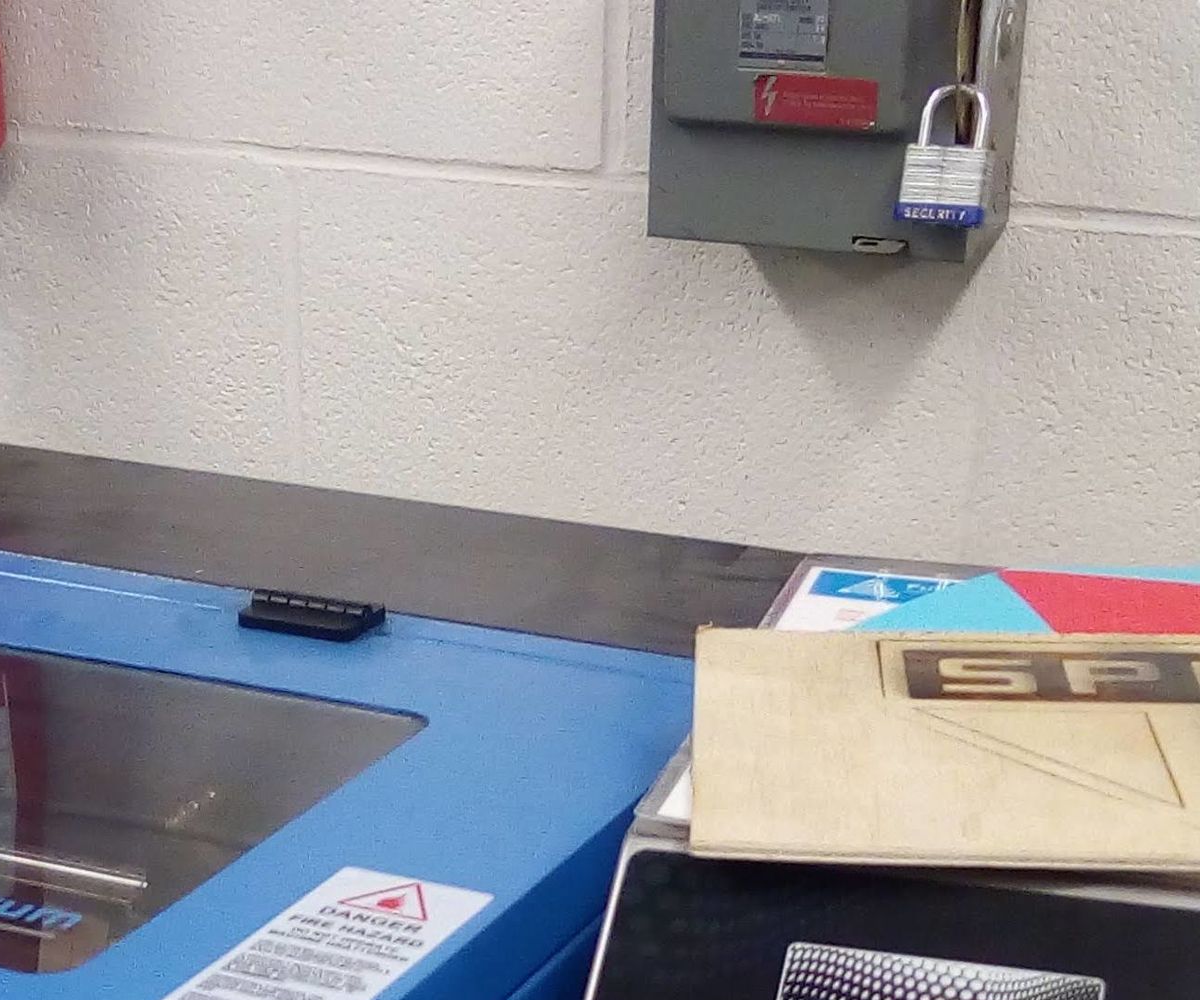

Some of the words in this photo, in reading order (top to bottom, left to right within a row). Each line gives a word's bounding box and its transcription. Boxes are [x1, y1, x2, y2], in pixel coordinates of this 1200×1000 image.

[937, 657, 1200, 696] SP
[288, 913, 335, 929] FIRE
[338, 924, 425, 948] HAZARD
[318, 905, 423, 934] DANGER
